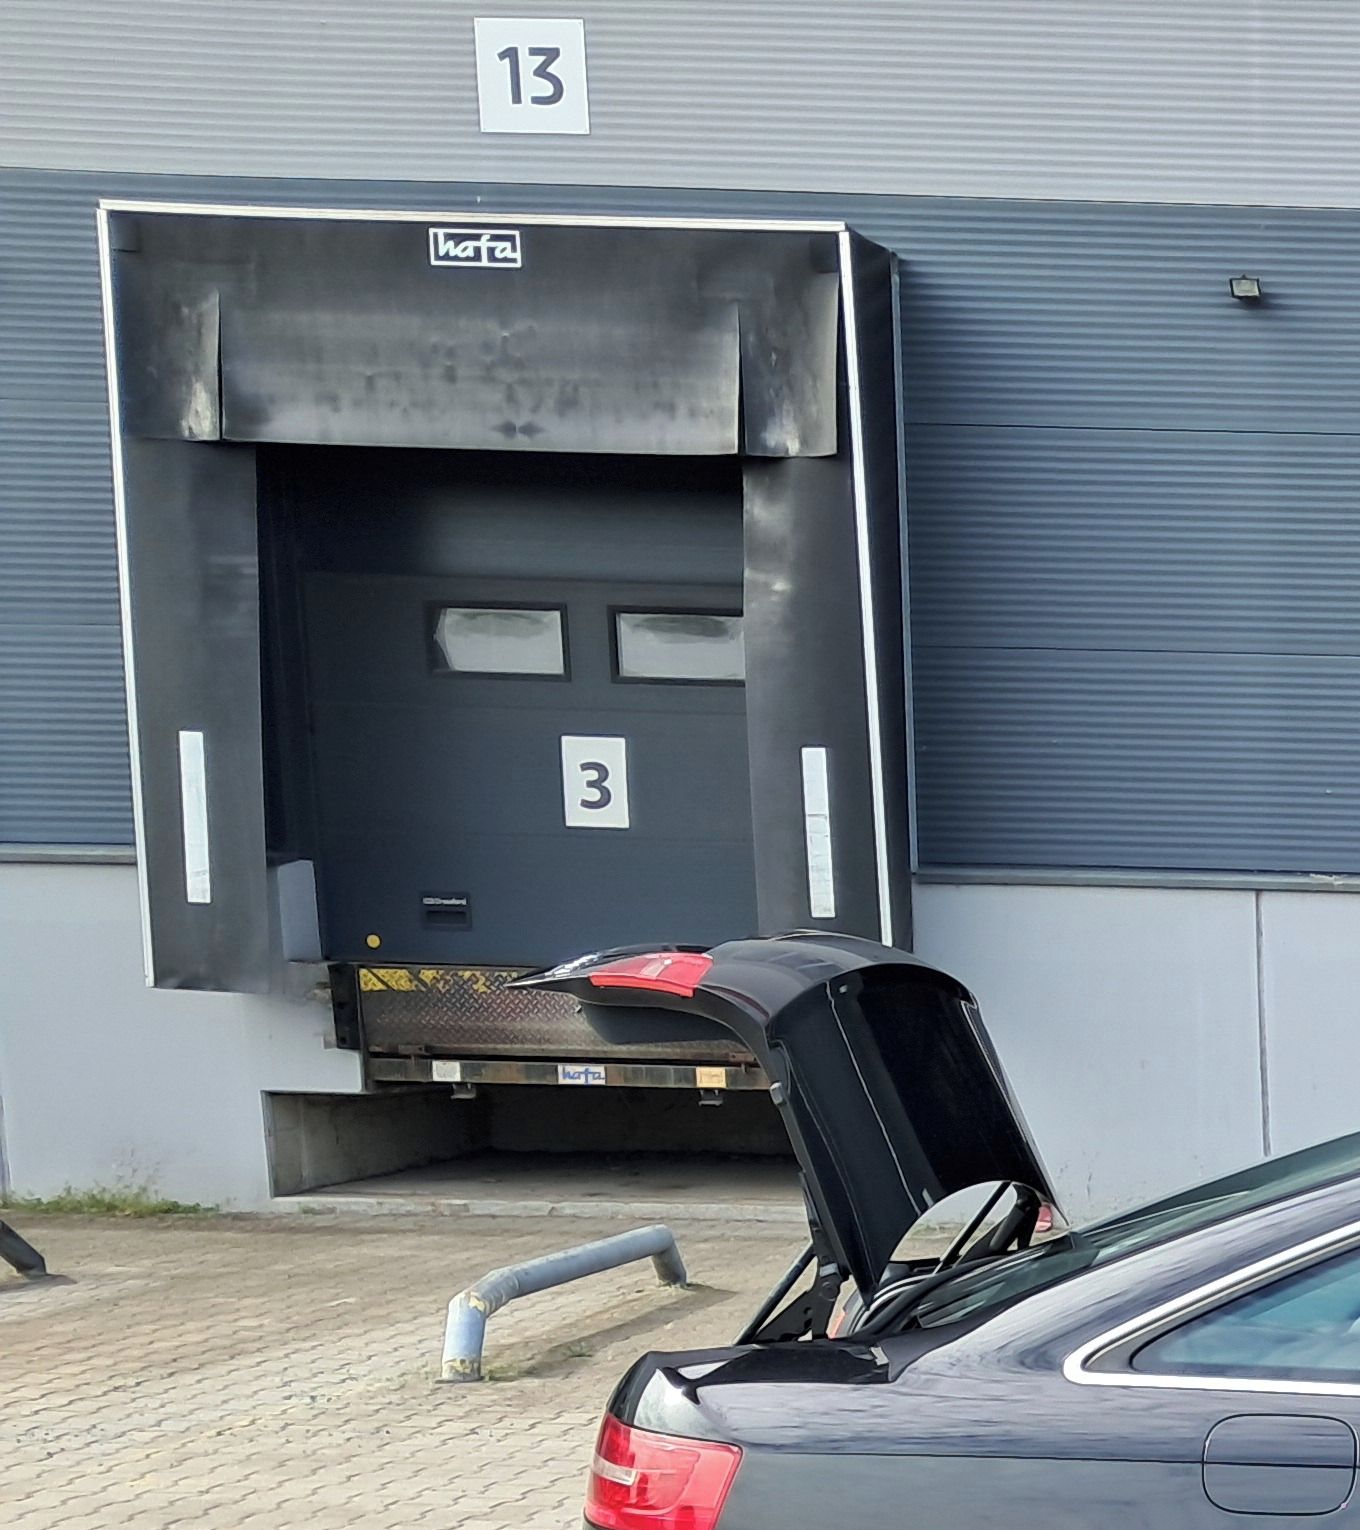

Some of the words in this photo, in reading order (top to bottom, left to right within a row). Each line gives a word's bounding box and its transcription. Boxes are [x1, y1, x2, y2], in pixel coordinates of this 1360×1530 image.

[496, 45, 566, 107] 13
[436, 231, 520, 264] hafa
[578, 761, 612, 811] 3
[561, 1065, 606, 1085] hafa
